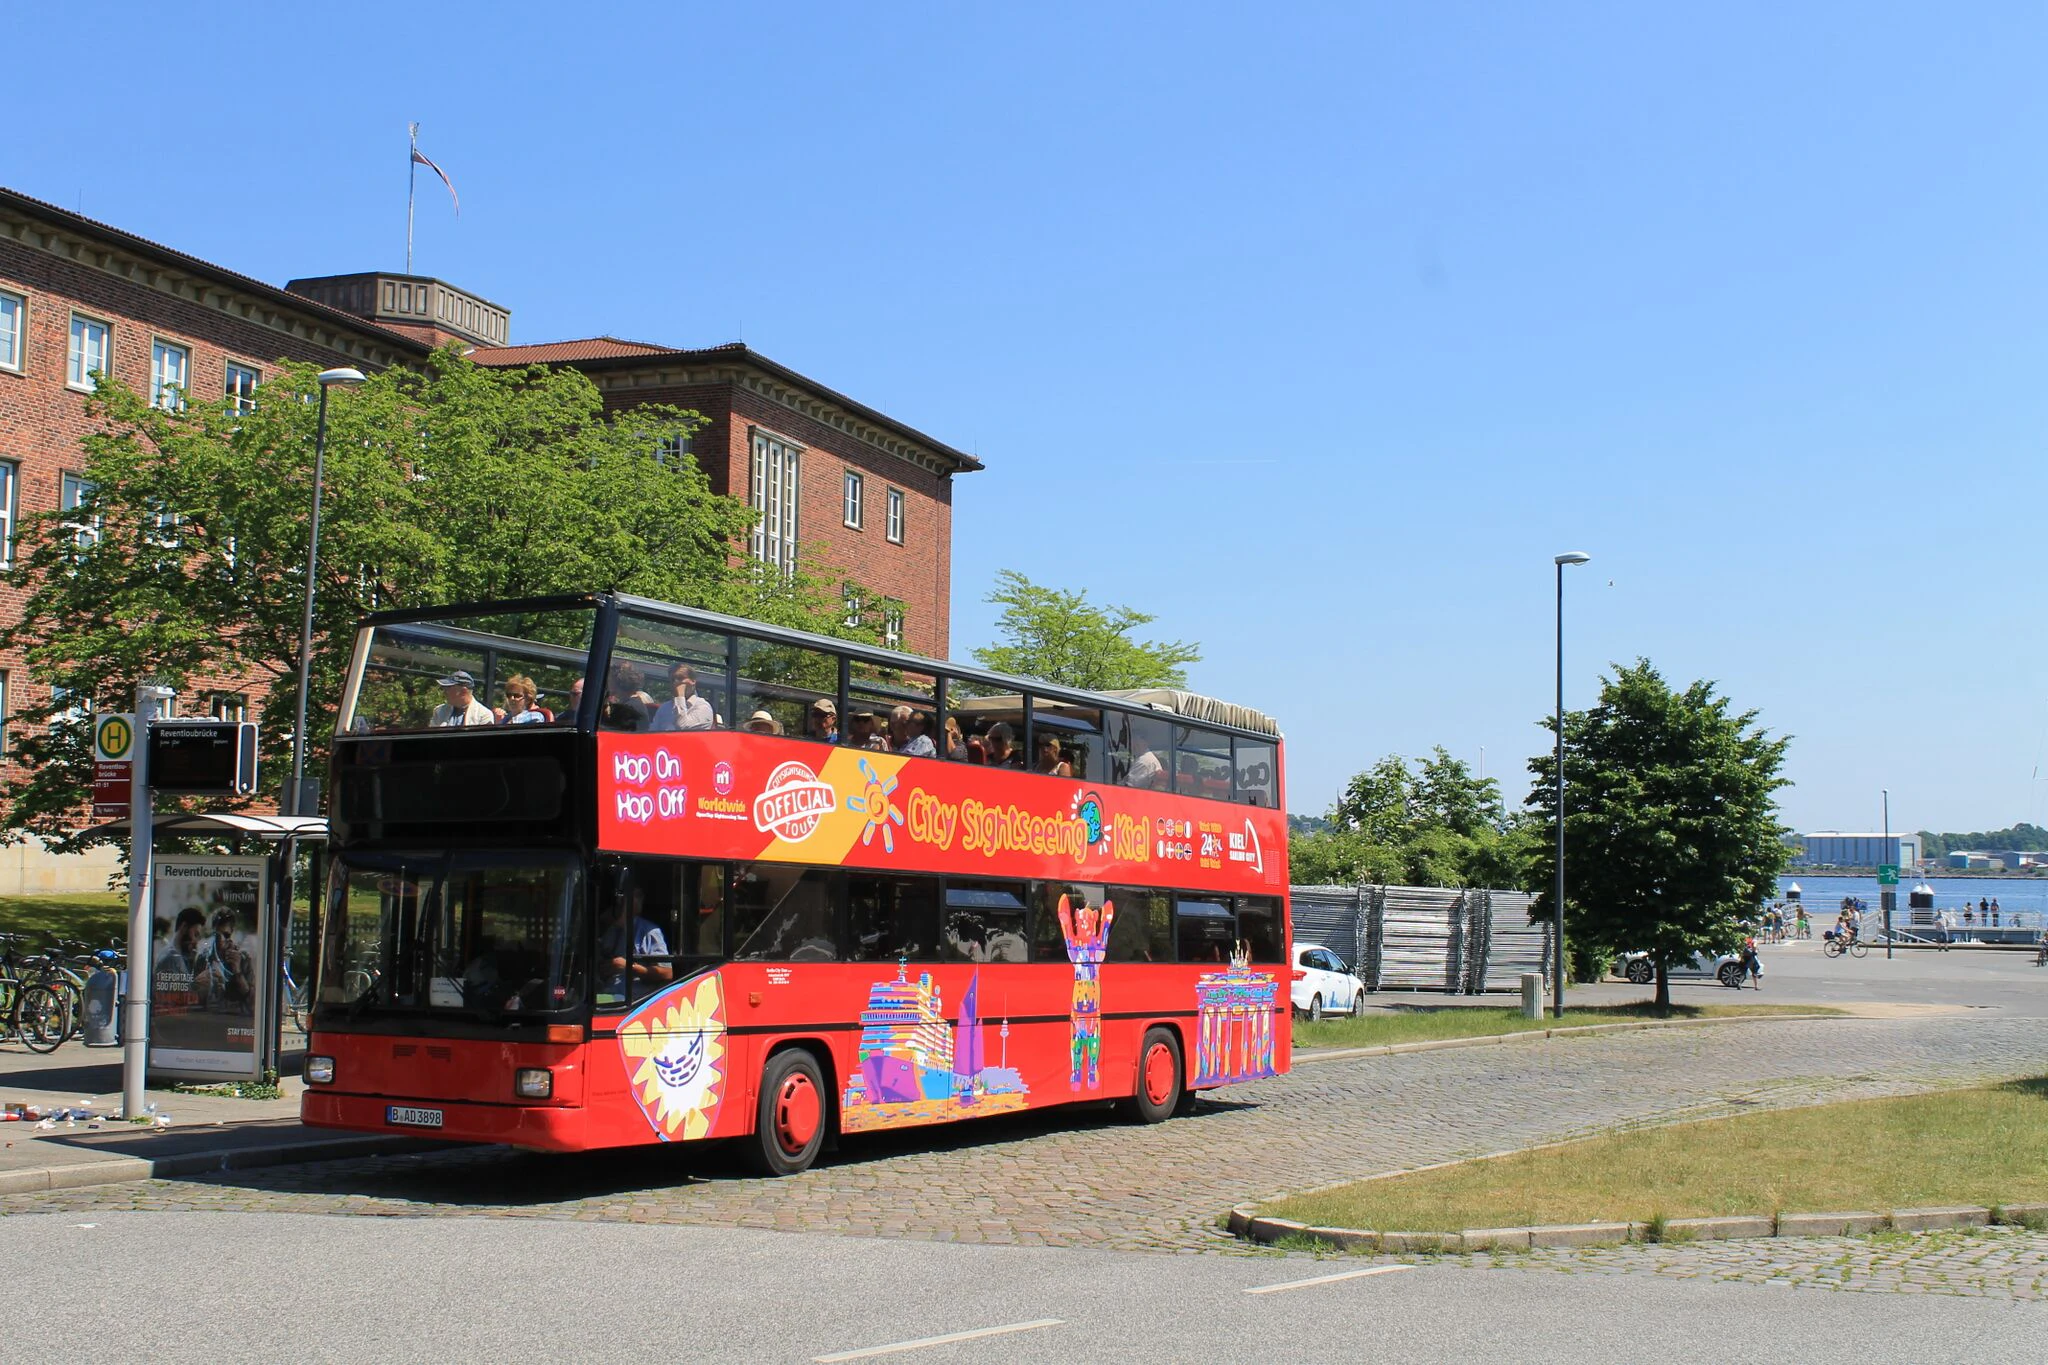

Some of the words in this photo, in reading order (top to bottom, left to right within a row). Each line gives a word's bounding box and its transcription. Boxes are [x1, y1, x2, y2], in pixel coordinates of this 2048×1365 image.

[107, 726, 121, 749] H
[160, 729, 218, 738] Reventloubrücke
[614, 755, 651, 783] Hop
[655, 749, 680, 779] On
[617, 790, 654, 822] Hop
[658, 786, 686, 817] Off
[763, 788, 833, 823] OFFICIAL
[785, 816, 815, 836] TOUR
[908, 787, 958, 851] City
[961, 798, 1089, 864] Sightseeing
[1114, 812, 1150, 862] Kiel
[1229, 832, 1246, 850] KIEL
[165, 865, 250, 878] Reventloubrücke
[223, 889, 256, 903] Winston
[161, 973, 194, 982] REPORTAGE
[156, 982, 169, 991] 500
[169, 983, 189, 992] FOTOS
[227, 1027, 240, 1036] STAY
[240, 1028, 256, 1036] TRUE
[392, 1108, 399, 1121] B
